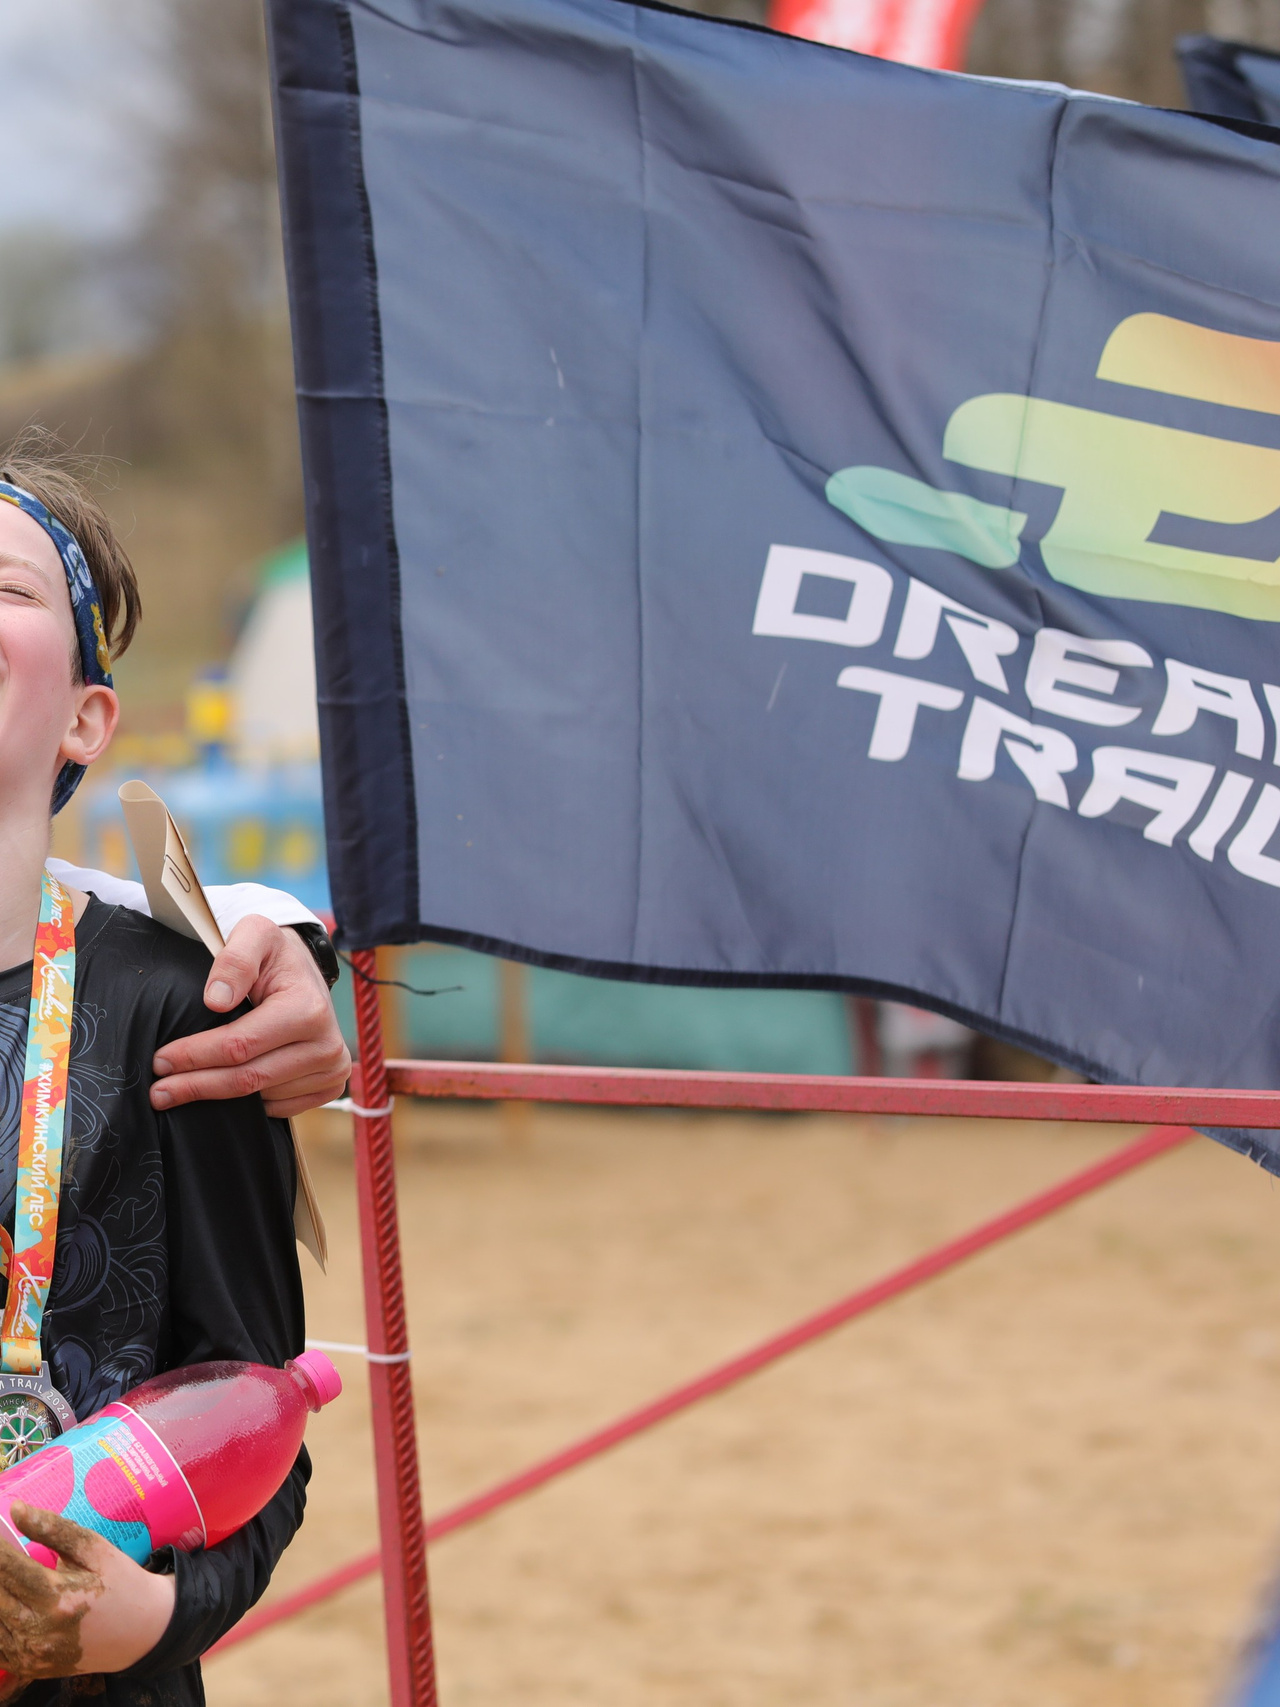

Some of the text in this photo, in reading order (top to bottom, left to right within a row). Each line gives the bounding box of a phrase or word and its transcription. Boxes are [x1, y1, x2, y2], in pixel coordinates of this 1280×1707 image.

[752, 544, 1280, 768] DREA
[50, 901, 63, 928] ЛЕС
[28, 1062, 53, 1227] #ХИМКИНСКИЙ ЛЕС
[9, 1377, 43, 1394] TRAIL
[46, 1391, 70, 1420] 2024
